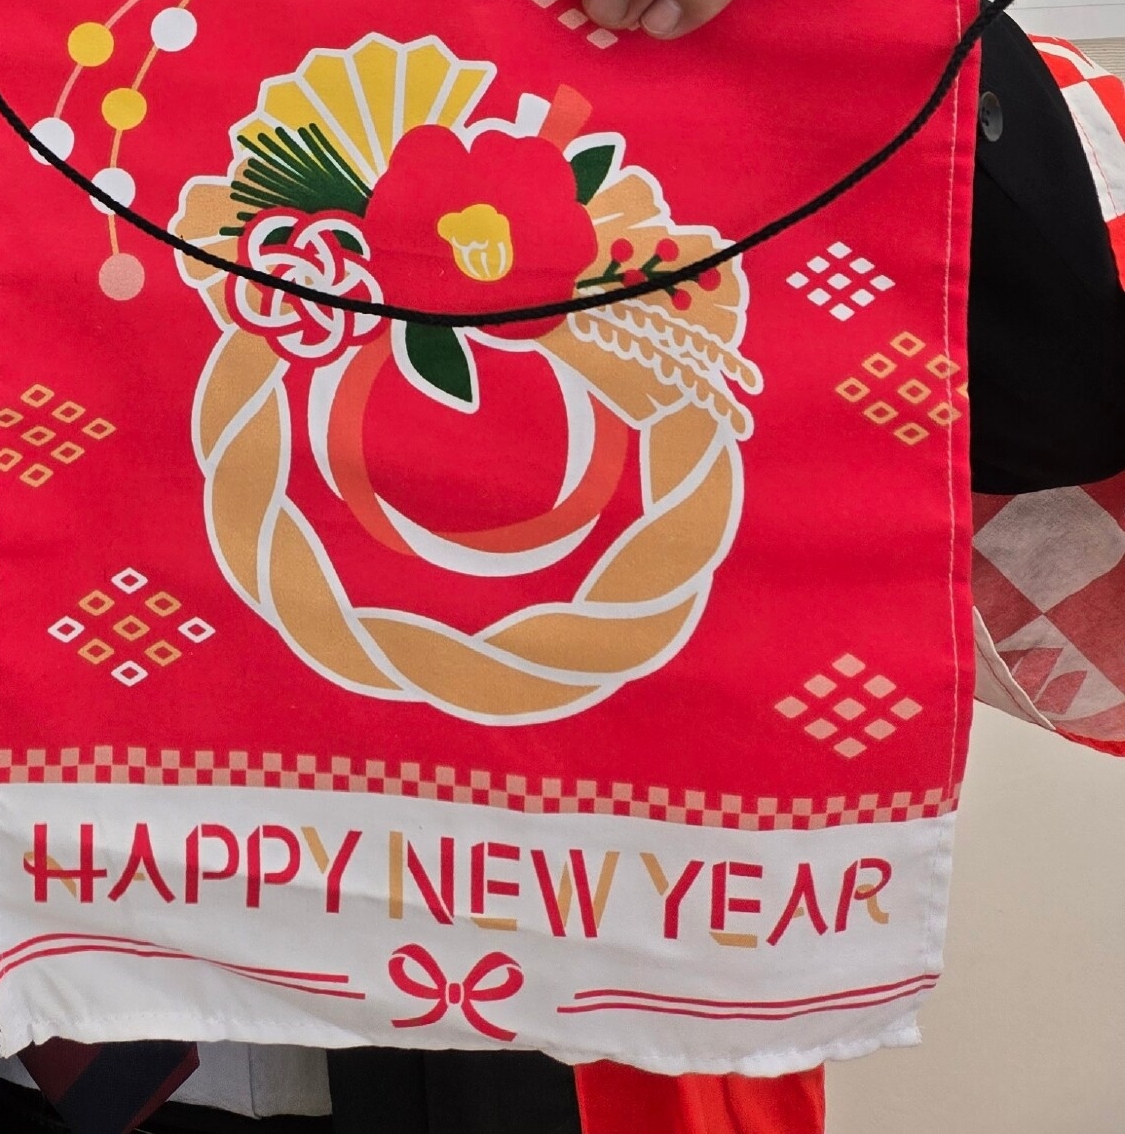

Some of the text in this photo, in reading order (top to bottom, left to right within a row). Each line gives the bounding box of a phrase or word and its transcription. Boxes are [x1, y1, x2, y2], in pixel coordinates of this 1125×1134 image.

[23, 822, 893, 949] HAPPY NEW YEAR
